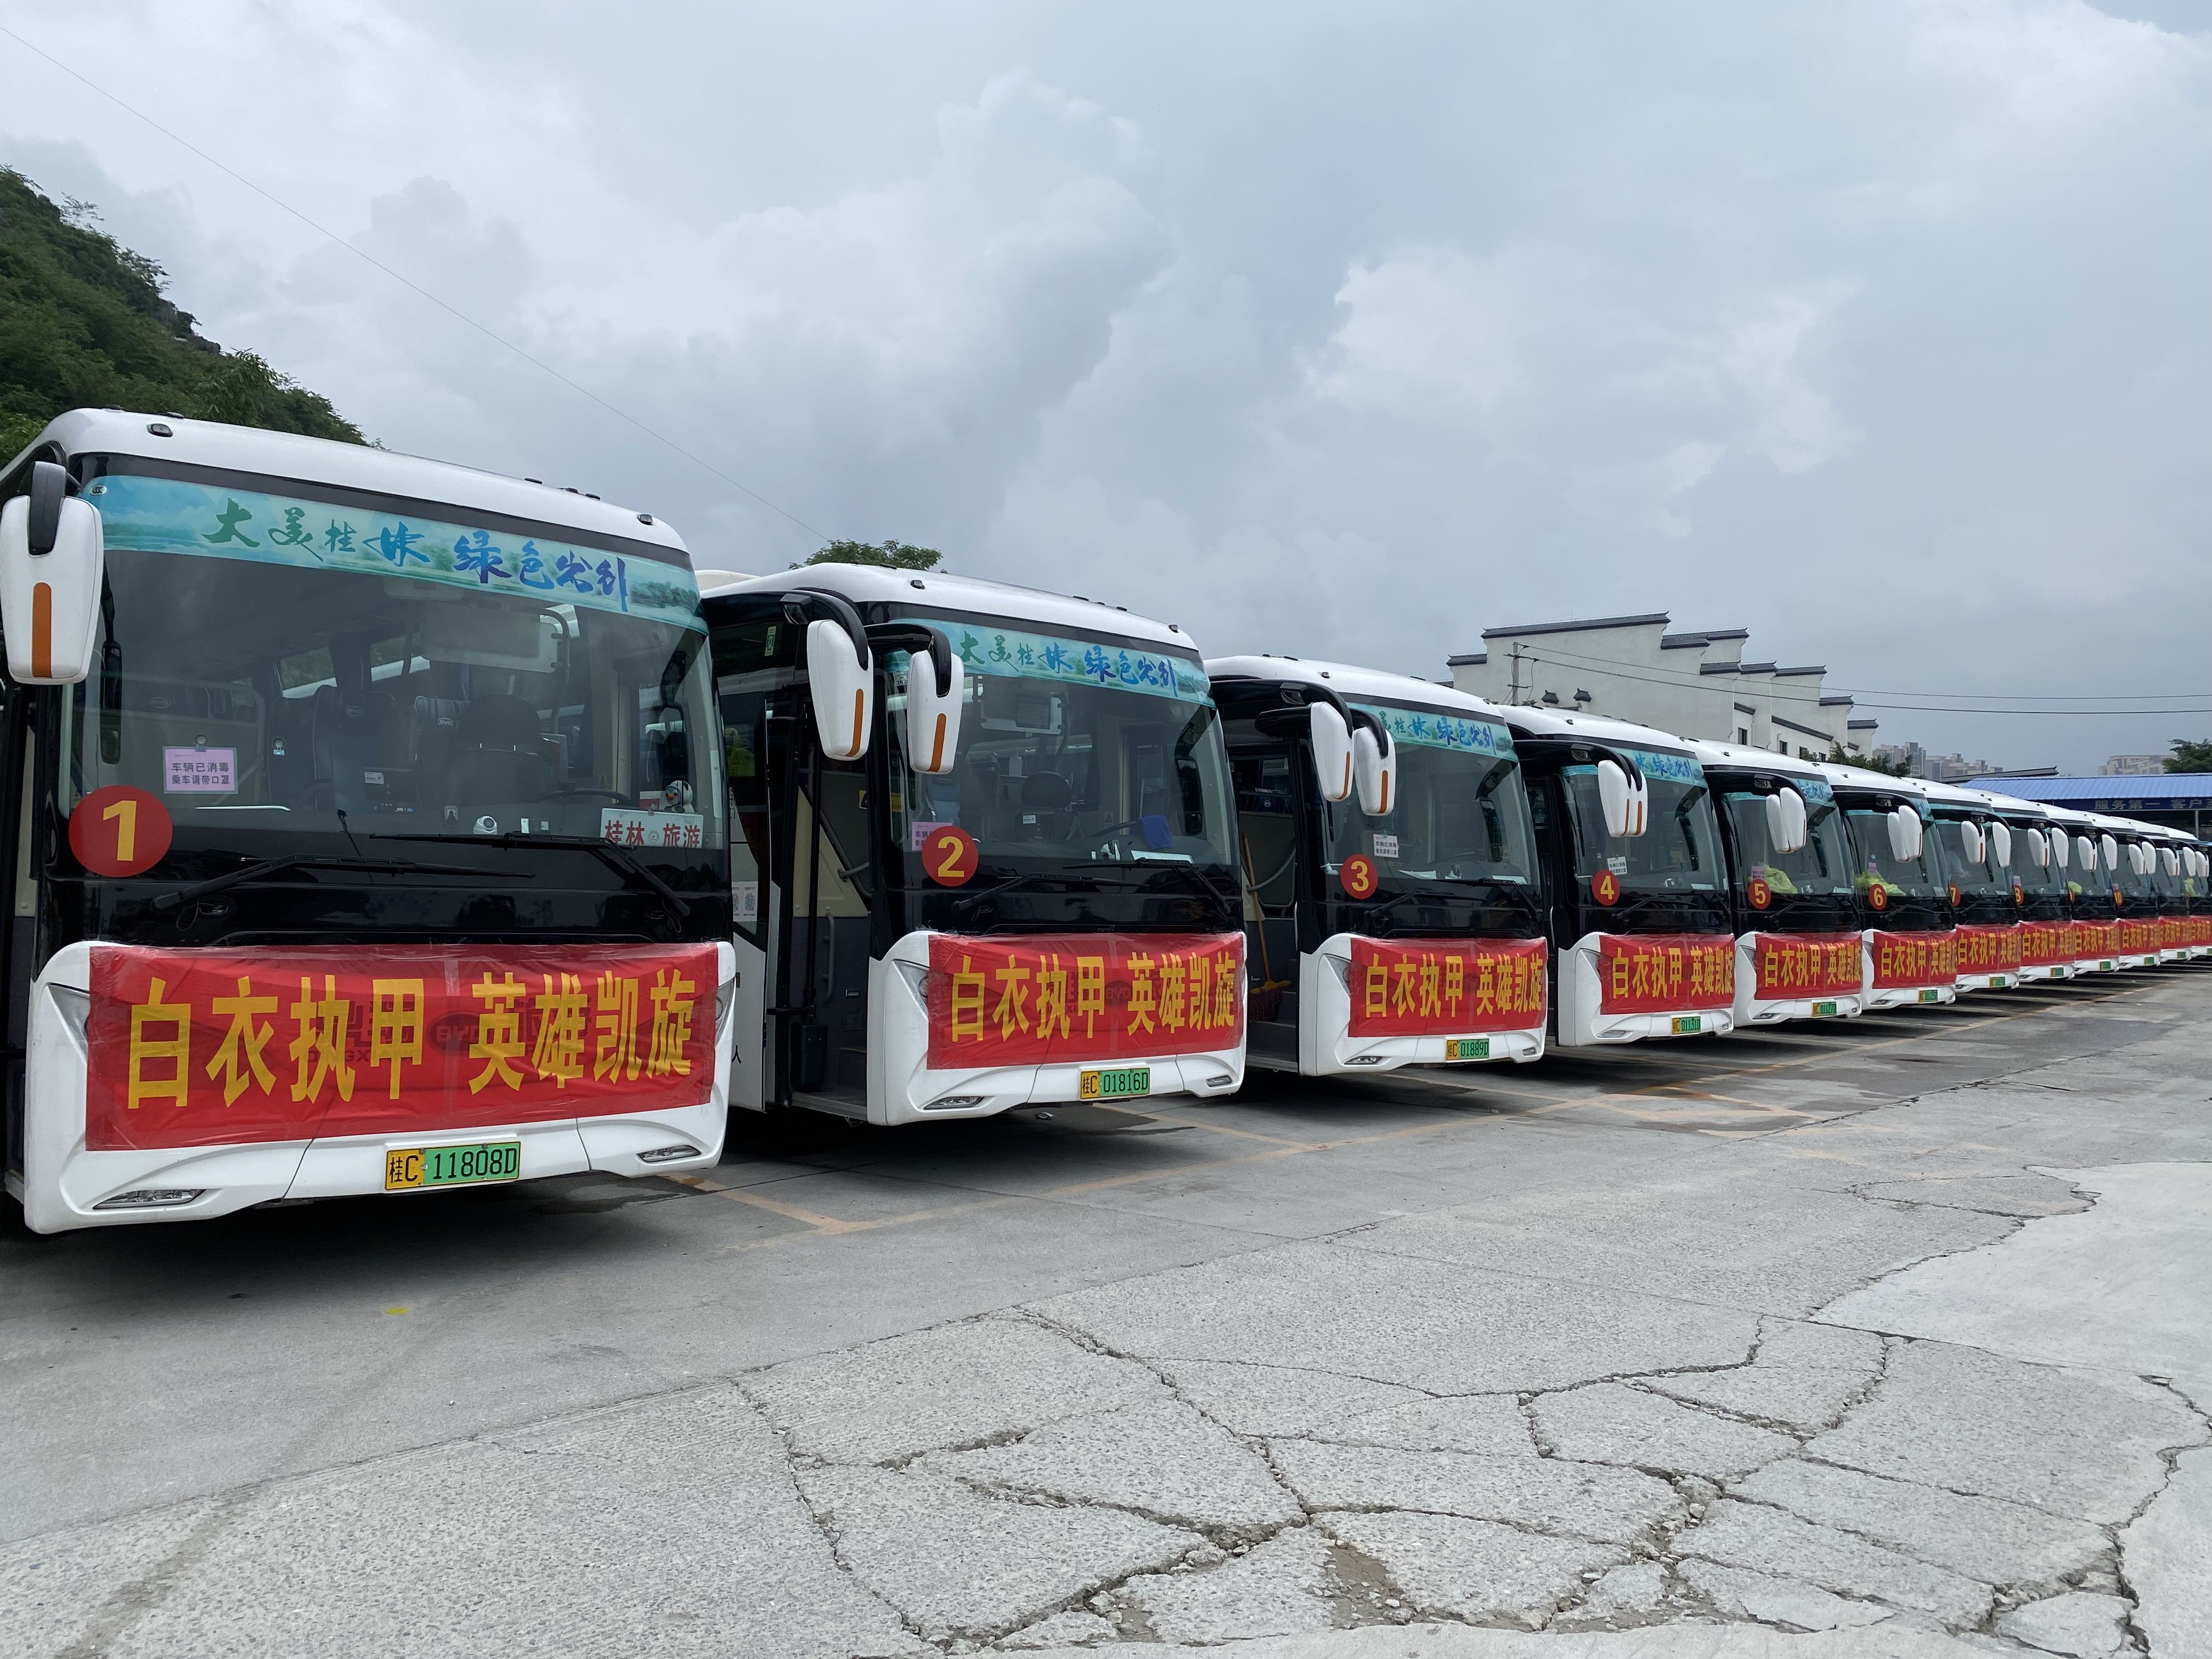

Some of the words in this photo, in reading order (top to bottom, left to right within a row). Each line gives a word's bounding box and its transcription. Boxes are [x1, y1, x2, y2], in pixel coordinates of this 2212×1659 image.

[201, 497, 431, 567] 大美桂林
[454, 530, 628, 612] 绿色出行
[1085, 645, 1178, 697] 绿色出行
[1437, 715, 1497, 756] 绿色出行
[171, 762, 229, 772] 车辆已消毒
[172, 775, 229, 785] 乘车请带口罩
[2095, 799, 2160, 810] 服务第一
[103, 801, 137, 861] 1
[605, 820, 645, 847] 桂林
[663, 823, 700, 848] 旅游
[938, 836, 964, 877] 2
[1352, 861, 1369, 891] 3
[1600, 876, 1615, 900] 4
[1754, 883, 1767, 905] 5
[1874, 887, 1884, 906] 6
[1950, 887, 1956, 903] 7
[2015, 887, 2022, 902] 8
[2114, 892, 2123, 904] 10
[1958, 932, 1996, 966] 白衣执甲
[2023, 928, 2056, 958] 白衣执甲
[2075, 926, 2103, 953] 白衣执甲
[1612, 946, 1682, 998] 白衣执甲
[1690, 945, 1733, 997] 英雄凯旋
[1765, 943, 1821, 987] 白衣执甲
[1881, 940, 1926, 978] 白衣执甲
[952, 953, 1105, 1042] 白衣执甲
[1127, 952, 1235, 1034] 英雄凯旋
[1365, 953, 1464, 1018] 白衣执甲
[1476, 952, 1543, 1015] 英雄凯旋
[128, 974, 424, 1109] 白衣执甲
[469, 969, 695, 1094] 英雄凯旋
